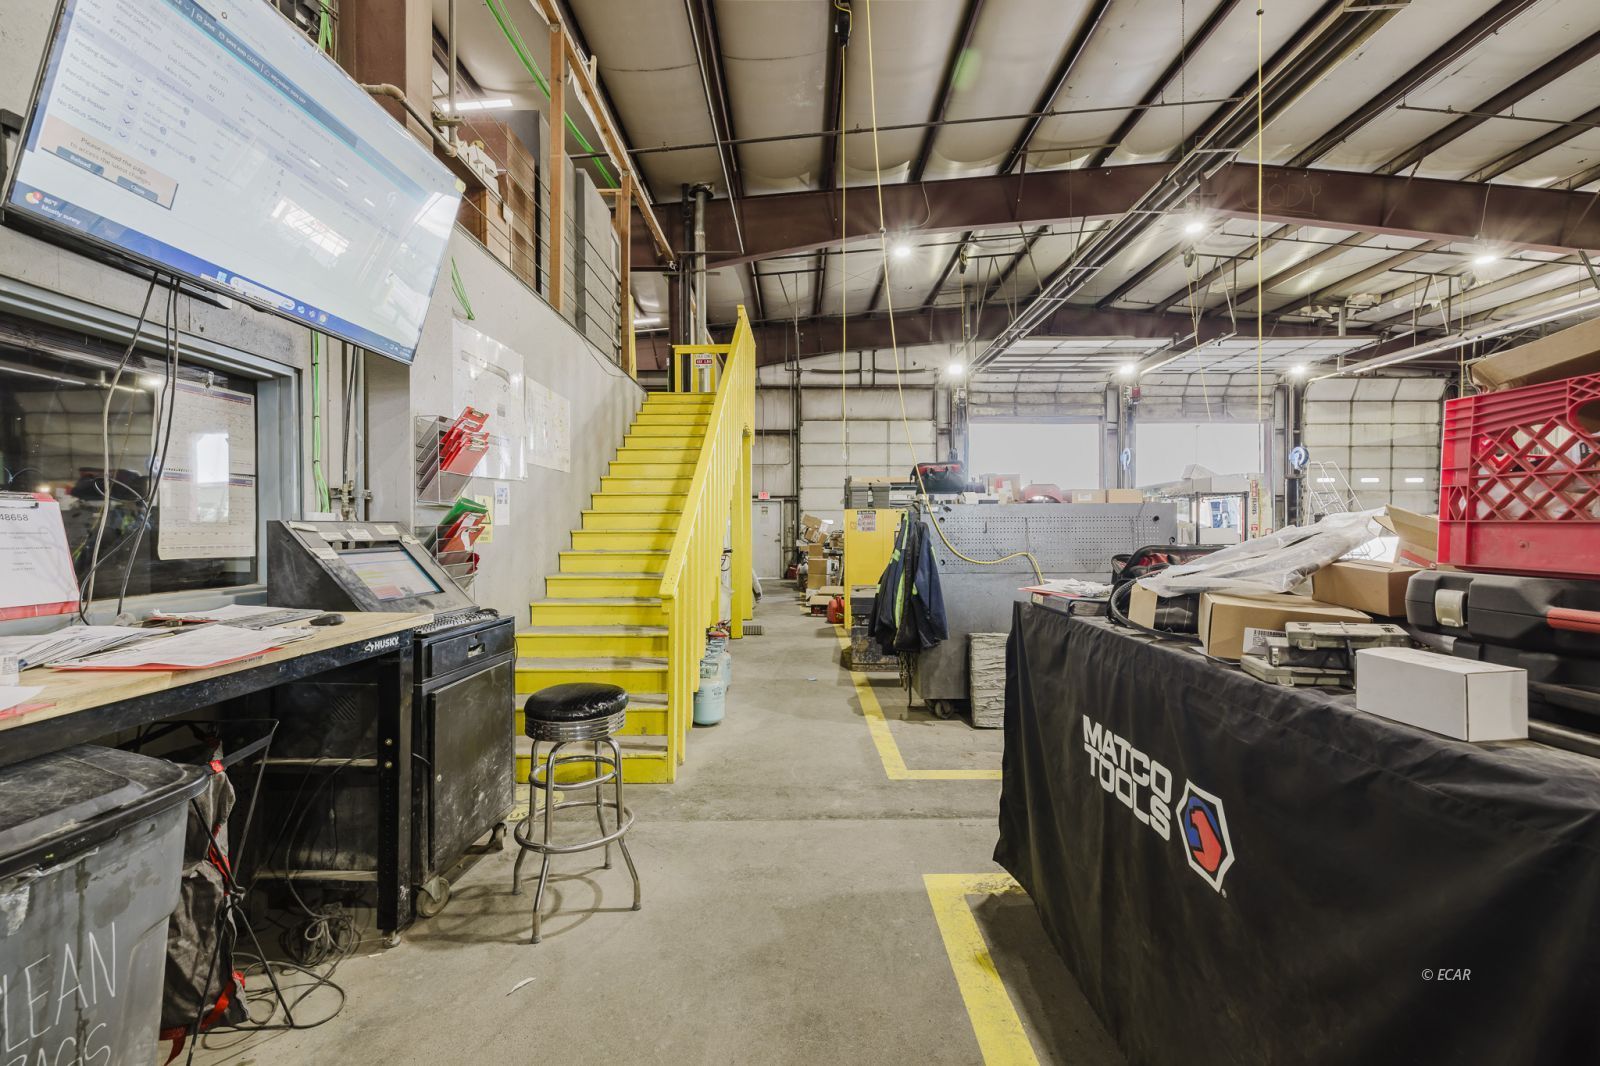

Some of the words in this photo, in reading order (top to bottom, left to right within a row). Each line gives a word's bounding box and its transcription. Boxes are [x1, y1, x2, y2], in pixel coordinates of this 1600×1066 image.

[374, 636, 400, 650] HUSKY
[1083, 714, 1172, 804] MATCO
[1084, 742, 1171, 841] TOOLS
[0, 921, 116, 1052] LEAN
